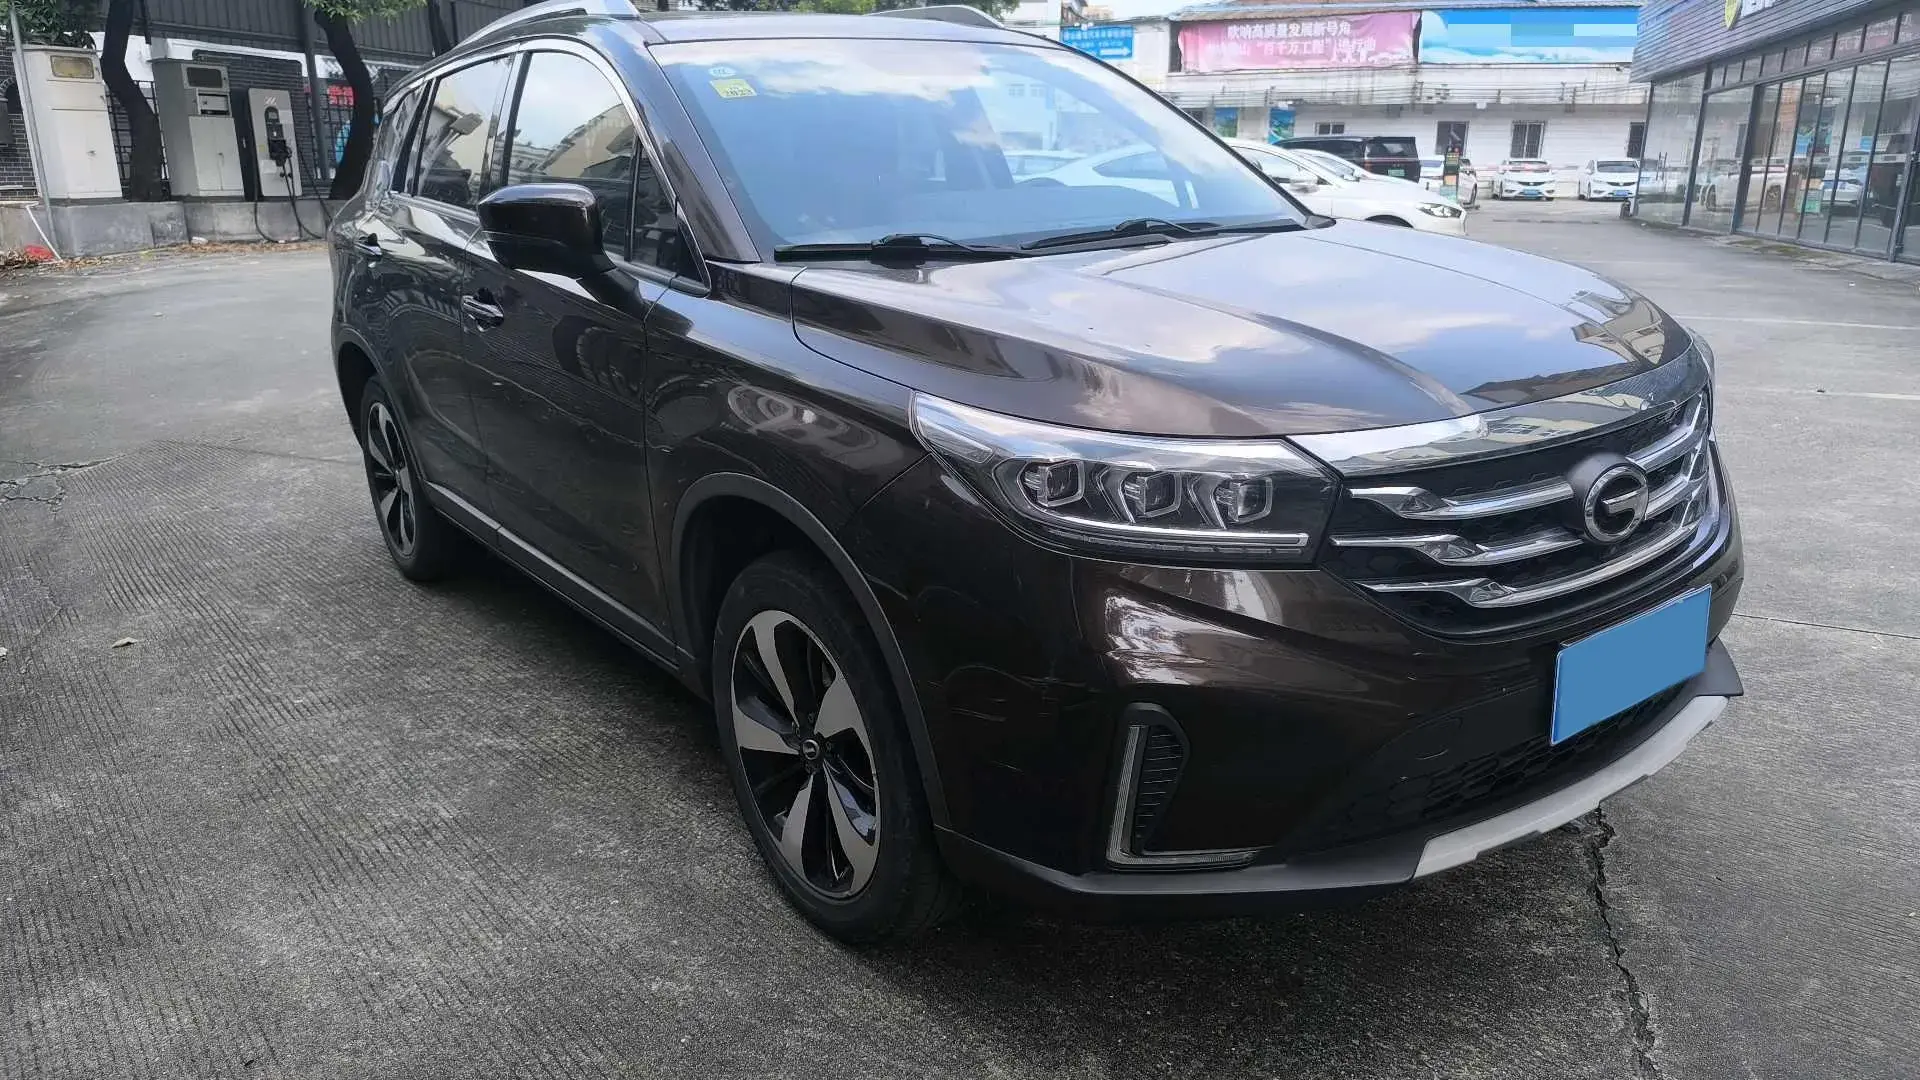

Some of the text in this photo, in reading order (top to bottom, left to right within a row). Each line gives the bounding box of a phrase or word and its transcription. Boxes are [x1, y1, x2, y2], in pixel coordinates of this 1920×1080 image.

[1227, 21, 1351, 40] 吹响高质量发展新号角
